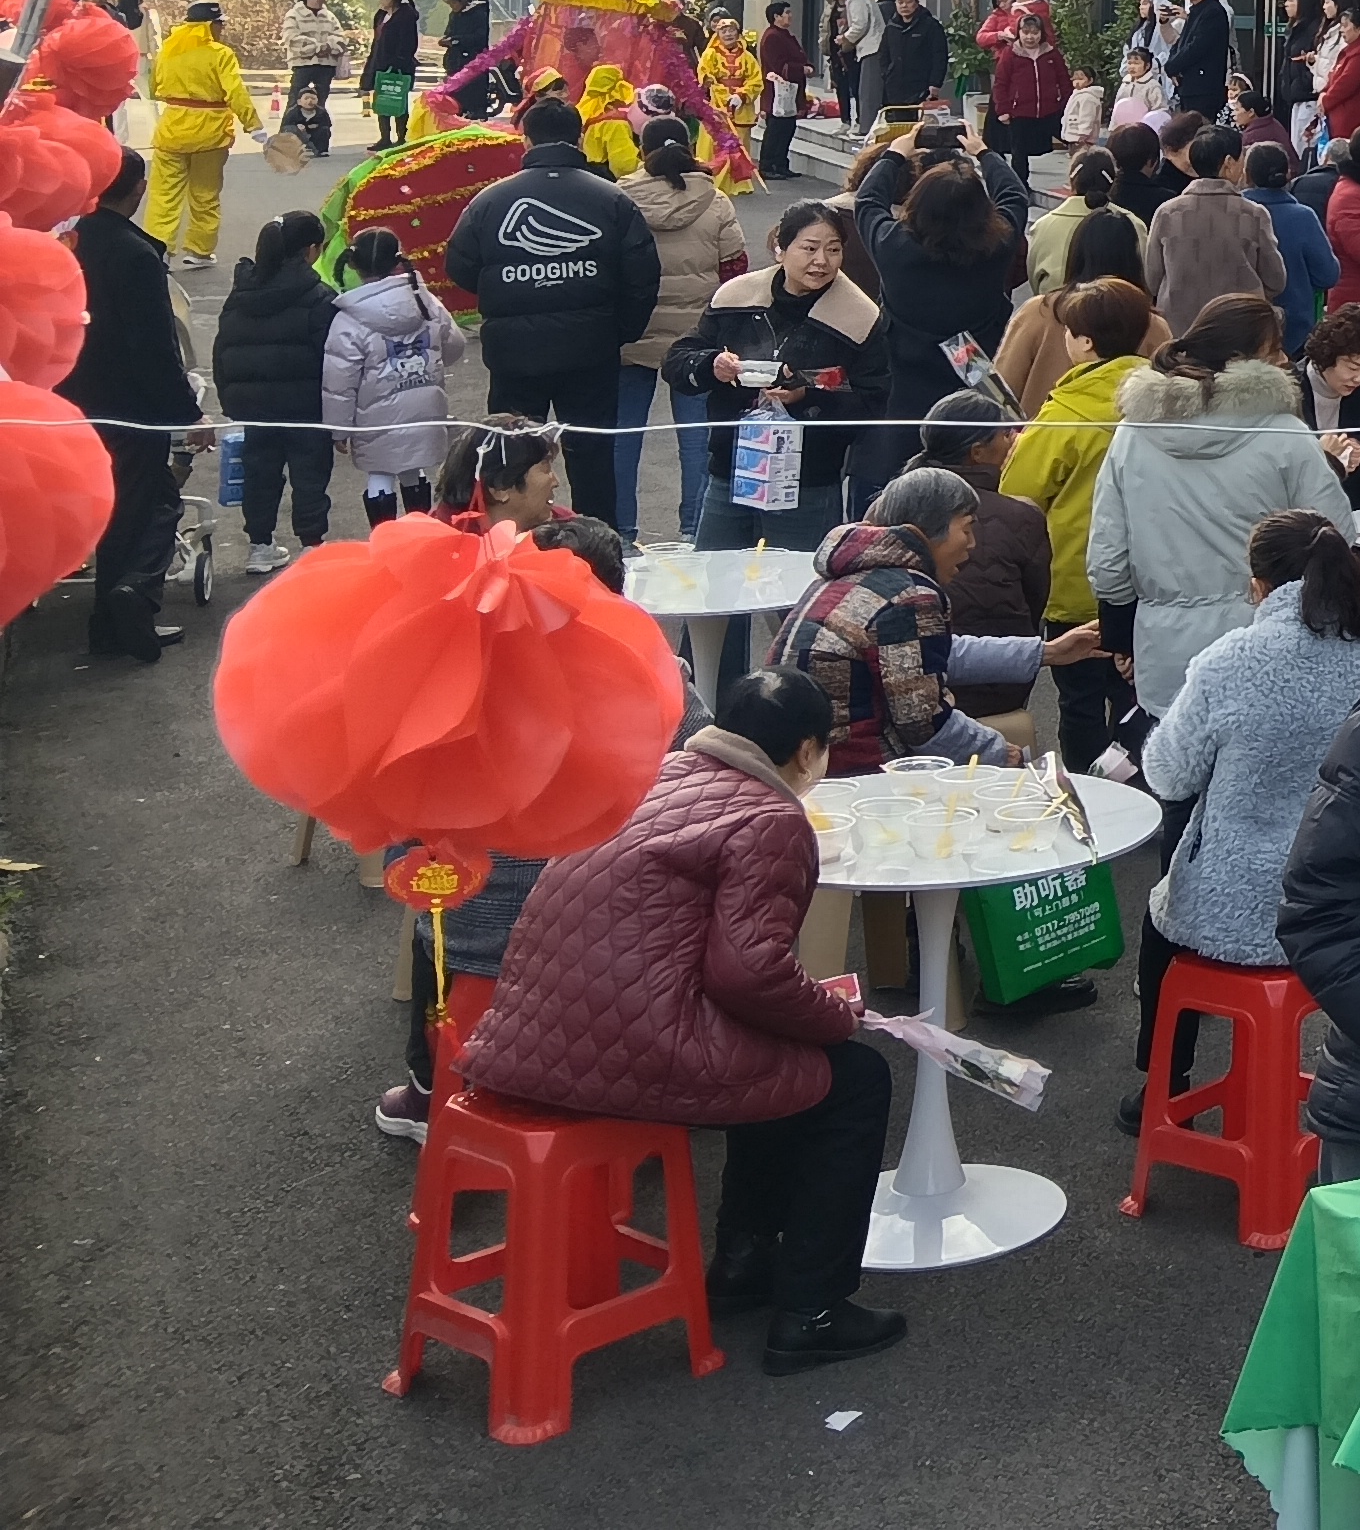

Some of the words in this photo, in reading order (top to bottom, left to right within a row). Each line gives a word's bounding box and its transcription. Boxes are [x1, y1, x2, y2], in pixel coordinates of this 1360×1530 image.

[502, 260, 598, 283] GOOGIMS
[1013, 870, 1087, 911] 助听器
